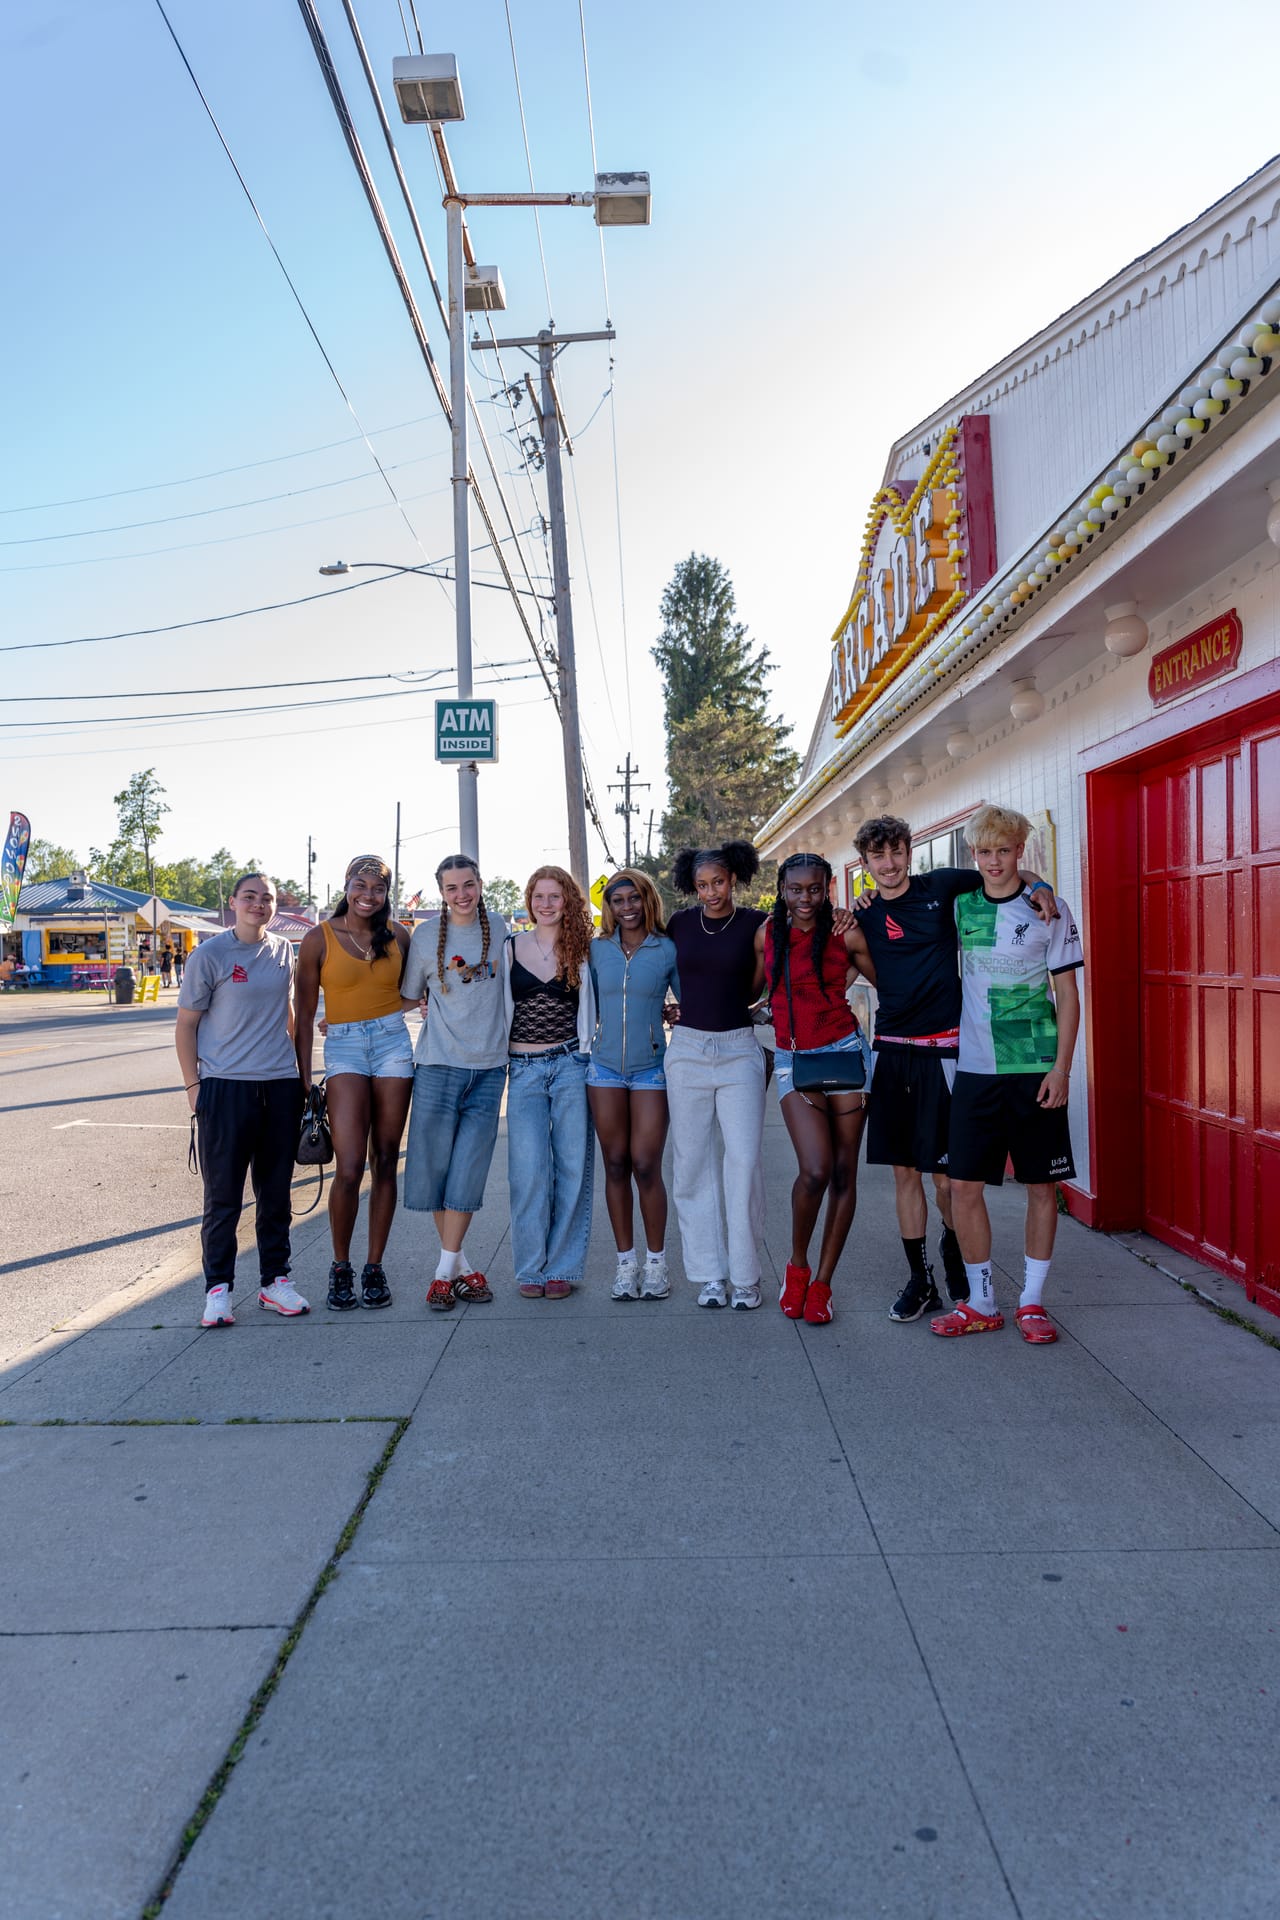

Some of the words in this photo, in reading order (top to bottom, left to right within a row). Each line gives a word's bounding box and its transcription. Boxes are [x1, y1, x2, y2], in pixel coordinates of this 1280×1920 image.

[831, 488, 940, 721] ARCADE
[1154, 624, 1231, 695] ENTRANCE
[440, 708, 491, 732] ATM
[443, 740, 488, 749] INSIDE
